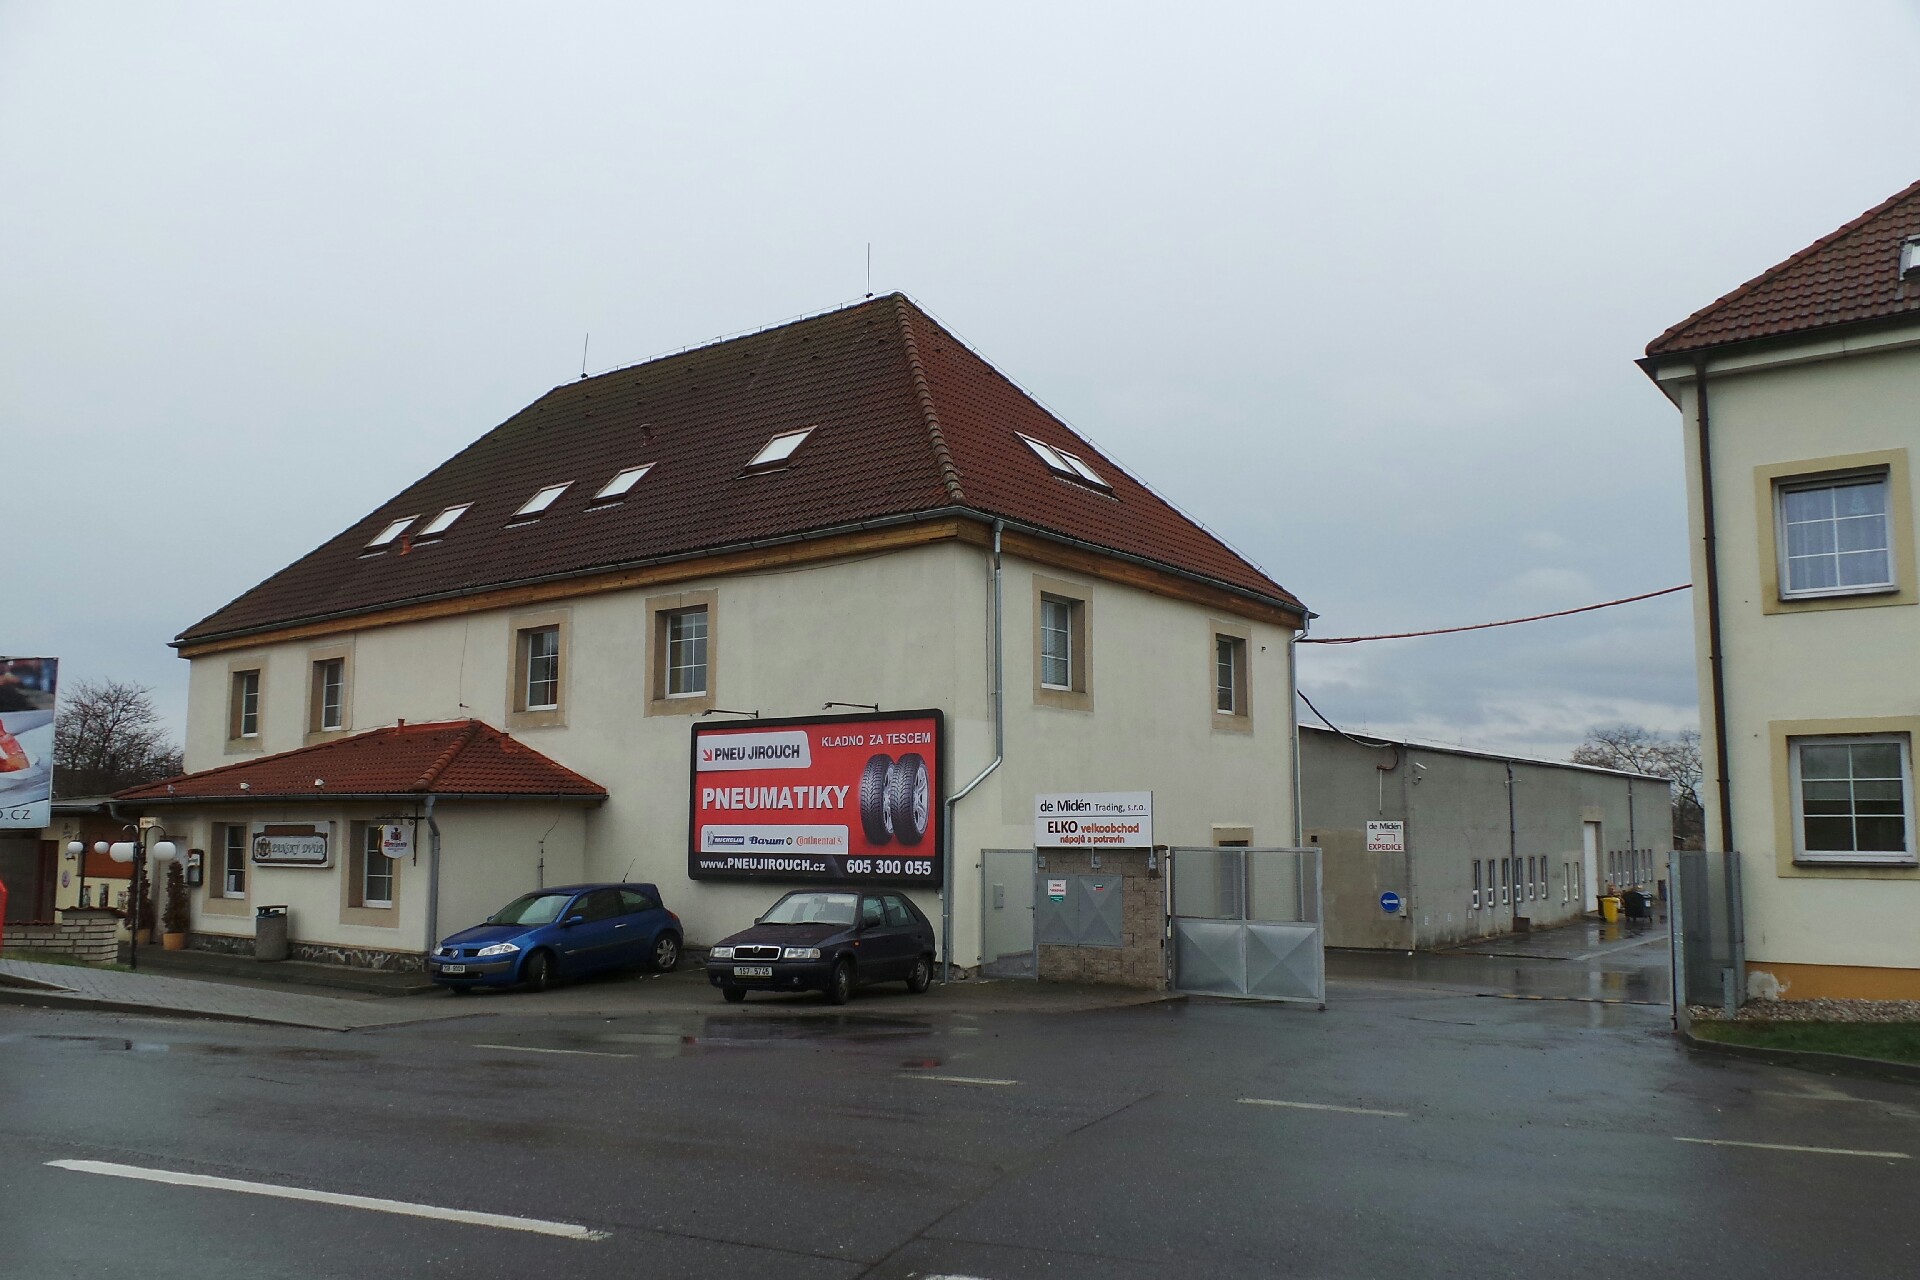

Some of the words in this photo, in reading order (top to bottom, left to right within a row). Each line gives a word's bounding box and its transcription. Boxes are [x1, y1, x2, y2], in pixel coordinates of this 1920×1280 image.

[821, 735, 864, 747] KLADNO
[869, 734, 885, 746] ZA
[886, 732, 931, 745] TESCEM
[714, 746, 746, 761] PNEU
[747, 744, 800, 760] JIROUCH
[702, 785, 850, 810] PNEUMATIKY
[1040, 800, 1054, 812] de
[1057, 799, 1091, 812] Midén
[1094, 803, 1126, 813] Trading,
[1127, 803, 1146, 811] s.r.o.
[1047, 820, 1078, 834] ELKO
[1080, 822, 1139, 834] velkoobchod
[1379, 822, 1402, 830] Midén
[749, 836, 785, 846] Barum
[796, 835, 836, 847] Continental
[1060, 835, 1085, 844] nápojů
[1093, 835, 1125, 845] potravin
[1368, 843, 1402, 851] EXPEDICE
[700, 857, 826, 872] www.PNEUJIROUCH.cz
[846, 859, 872, 874] 605
[875, 860, 901, 875] 300
[905, 860, 932, 876] 055
